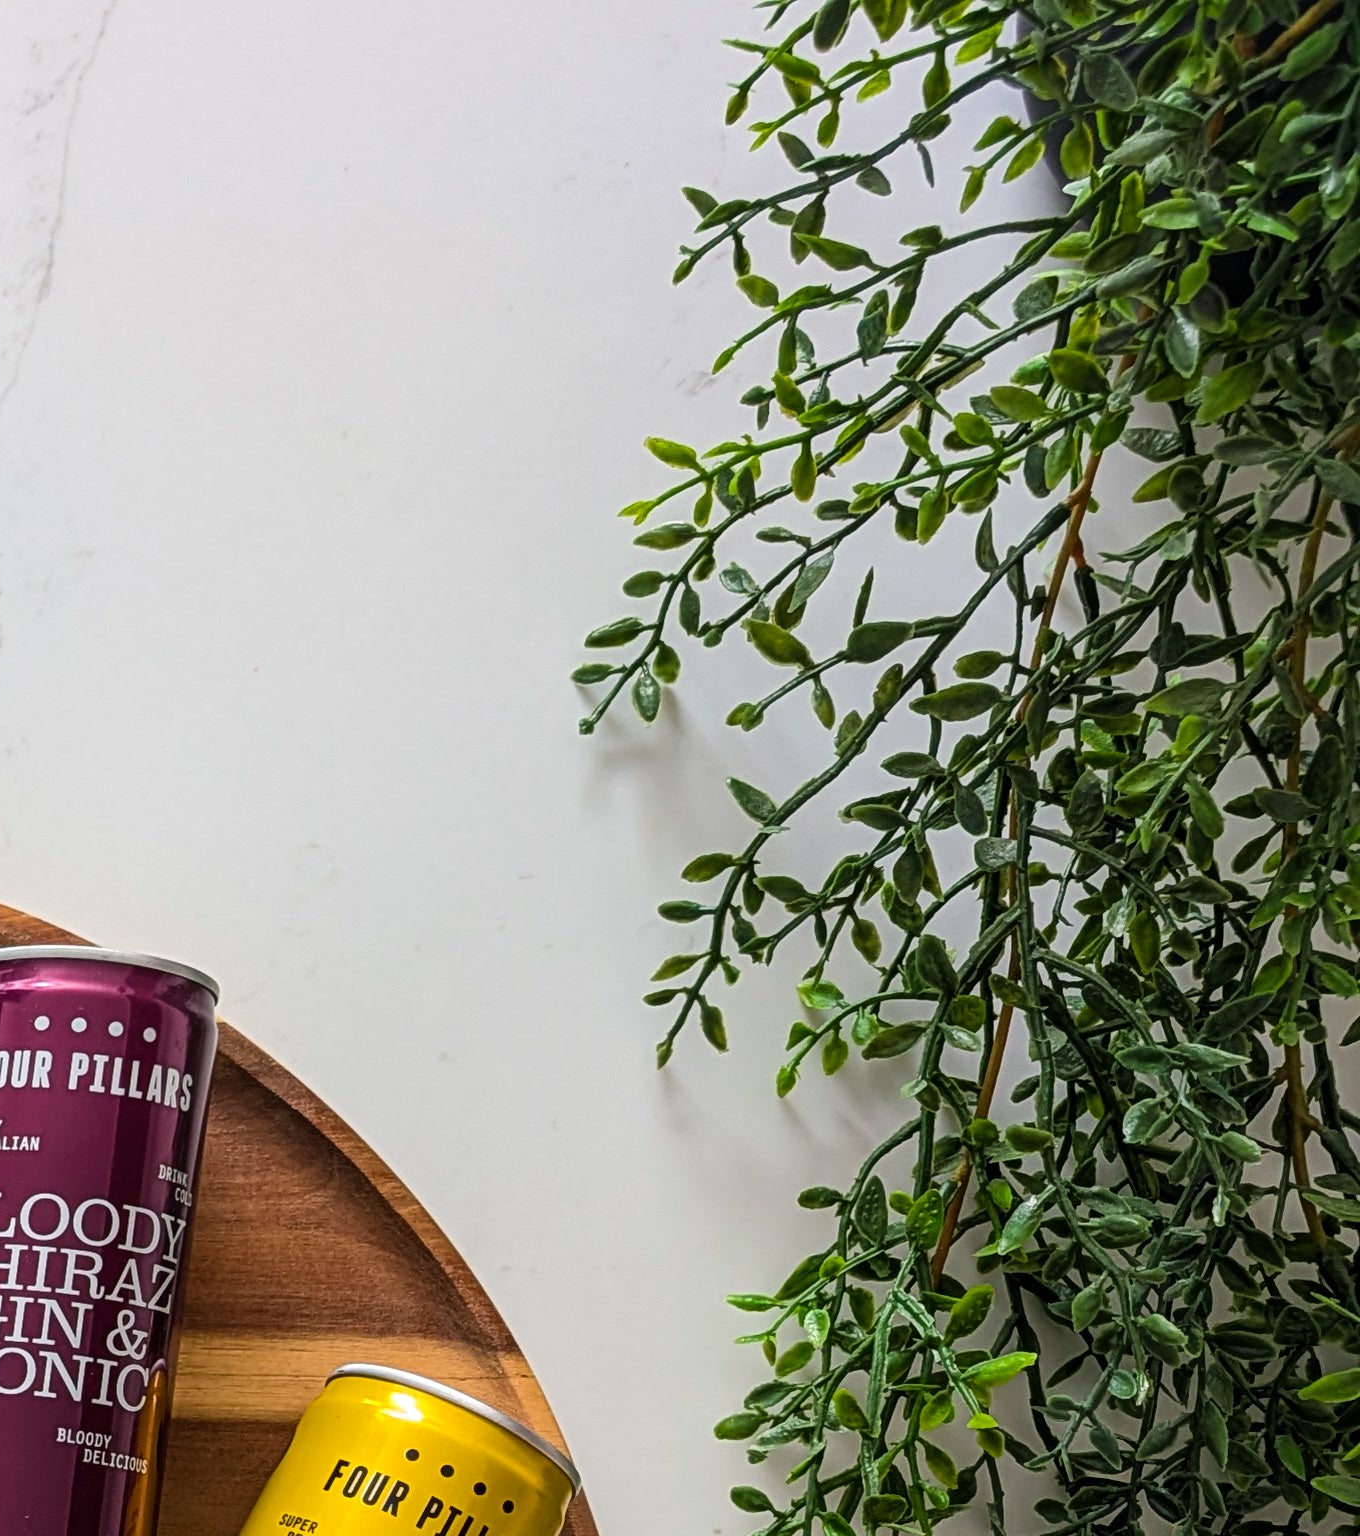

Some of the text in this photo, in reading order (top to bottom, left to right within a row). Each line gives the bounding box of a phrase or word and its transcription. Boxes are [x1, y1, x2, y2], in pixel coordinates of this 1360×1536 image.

[67, 1052, 193, 1112] PILLARS
[158, 1164, 188, 1187] DRINK
[106, 1309, 149, 1361] &
[56, 1427, 112, 1449] BLOODY
[83, 1448, 148, 1475] DELICIOUS
[323, 1459, 410, 1518] FOUR
[279, 1513, 318, 1536] SUPER
